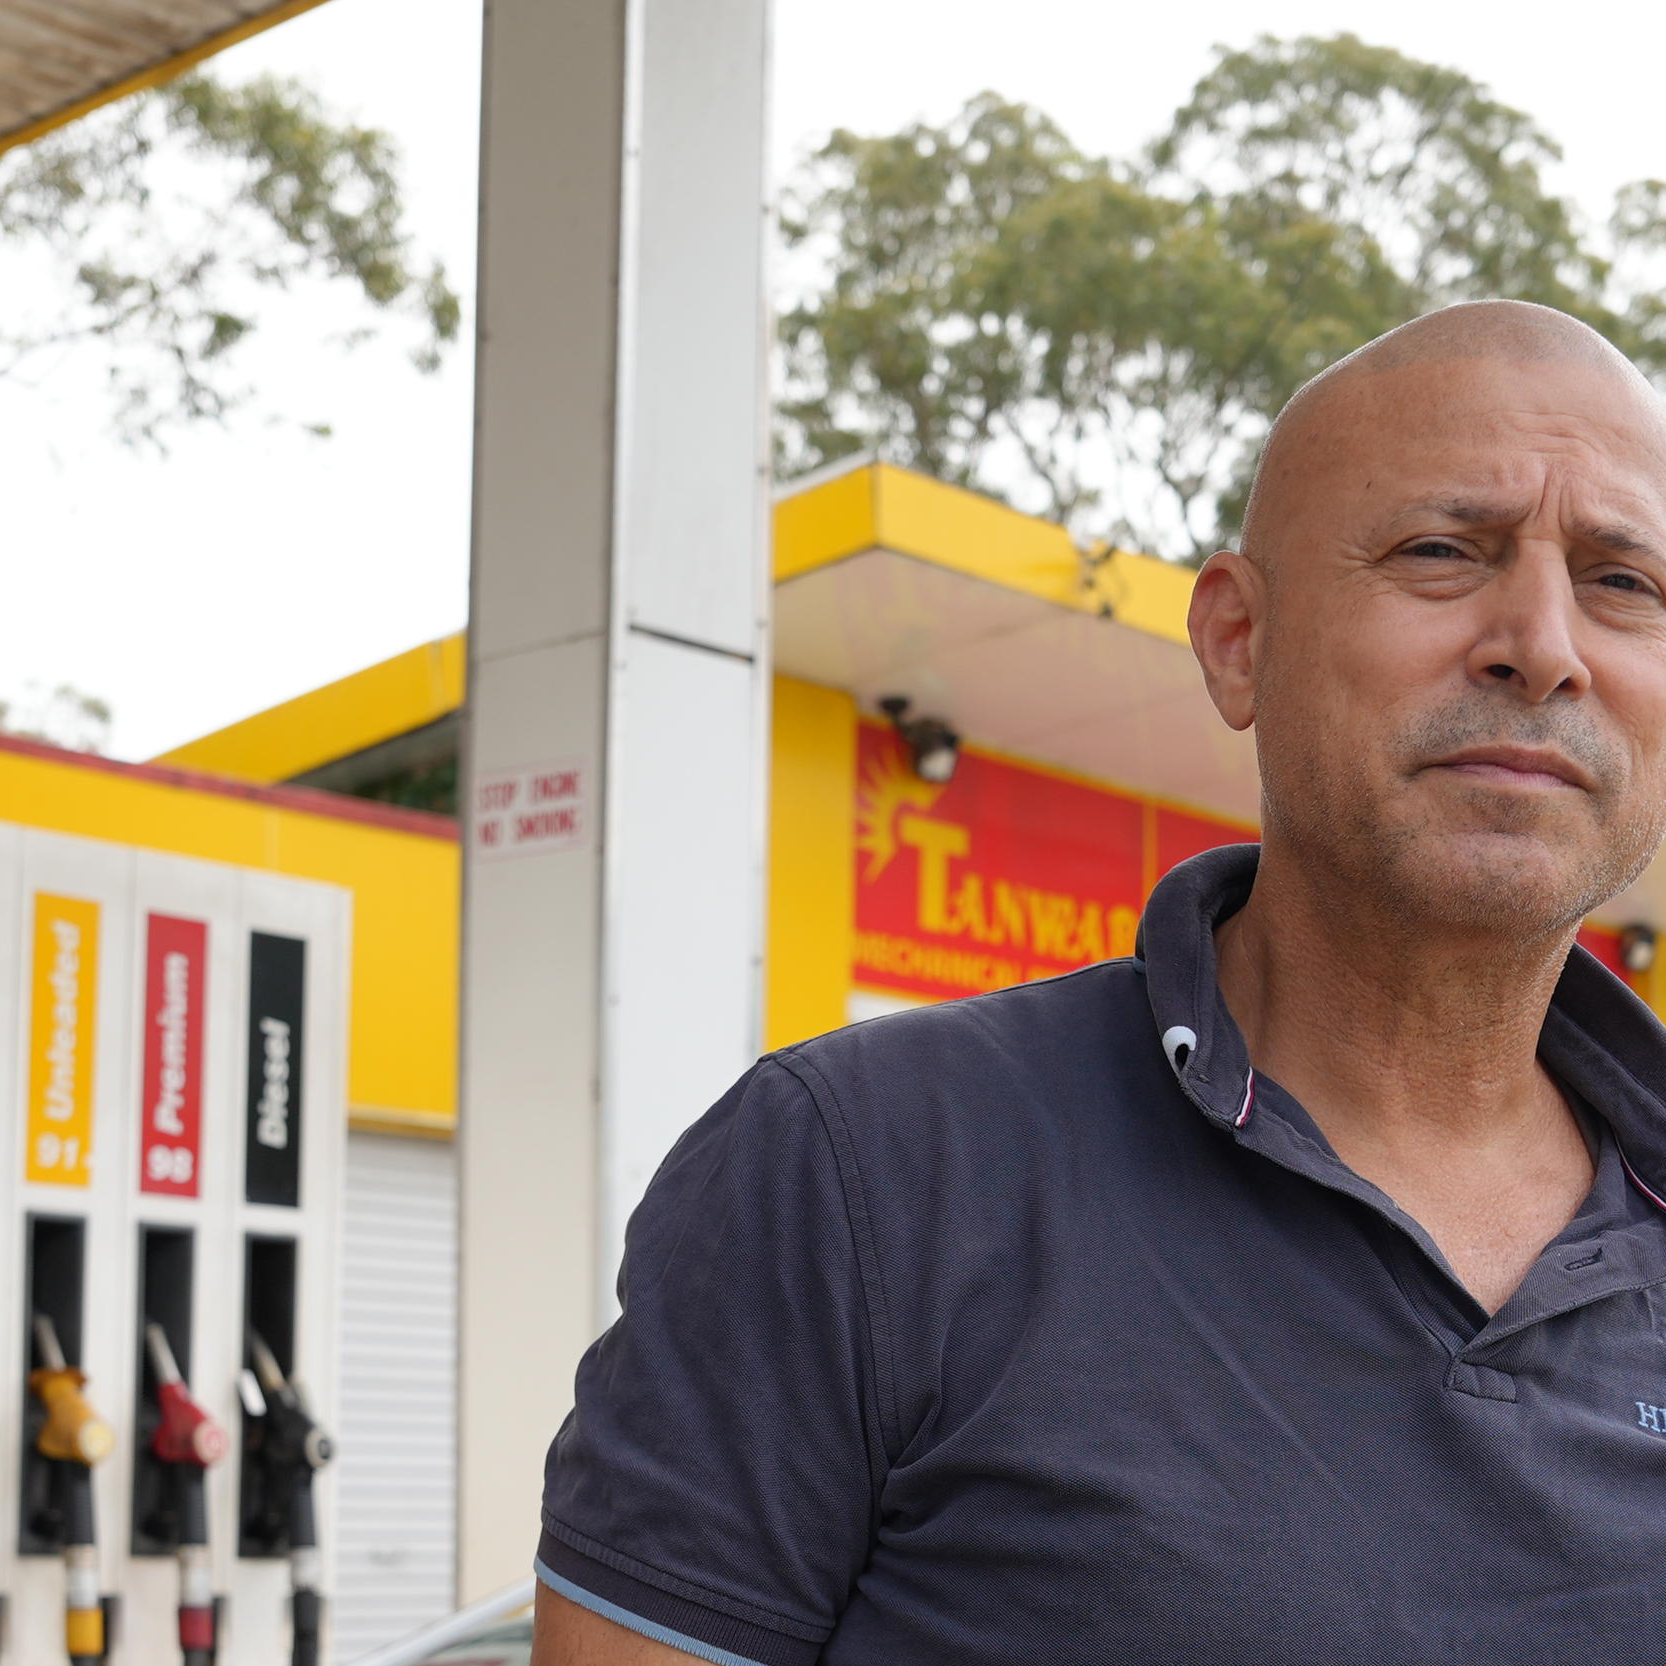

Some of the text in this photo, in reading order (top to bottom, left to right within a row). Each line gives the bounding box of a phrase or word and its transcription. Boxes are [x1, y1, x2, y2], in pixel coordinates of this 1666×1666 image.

[45, 920, 81, 1121] Unleaded
[155, 952, 189, 1136] Premium
[257, 1017, 291, 1150] Diesel
[147, 1145, 194, 1183] 98
